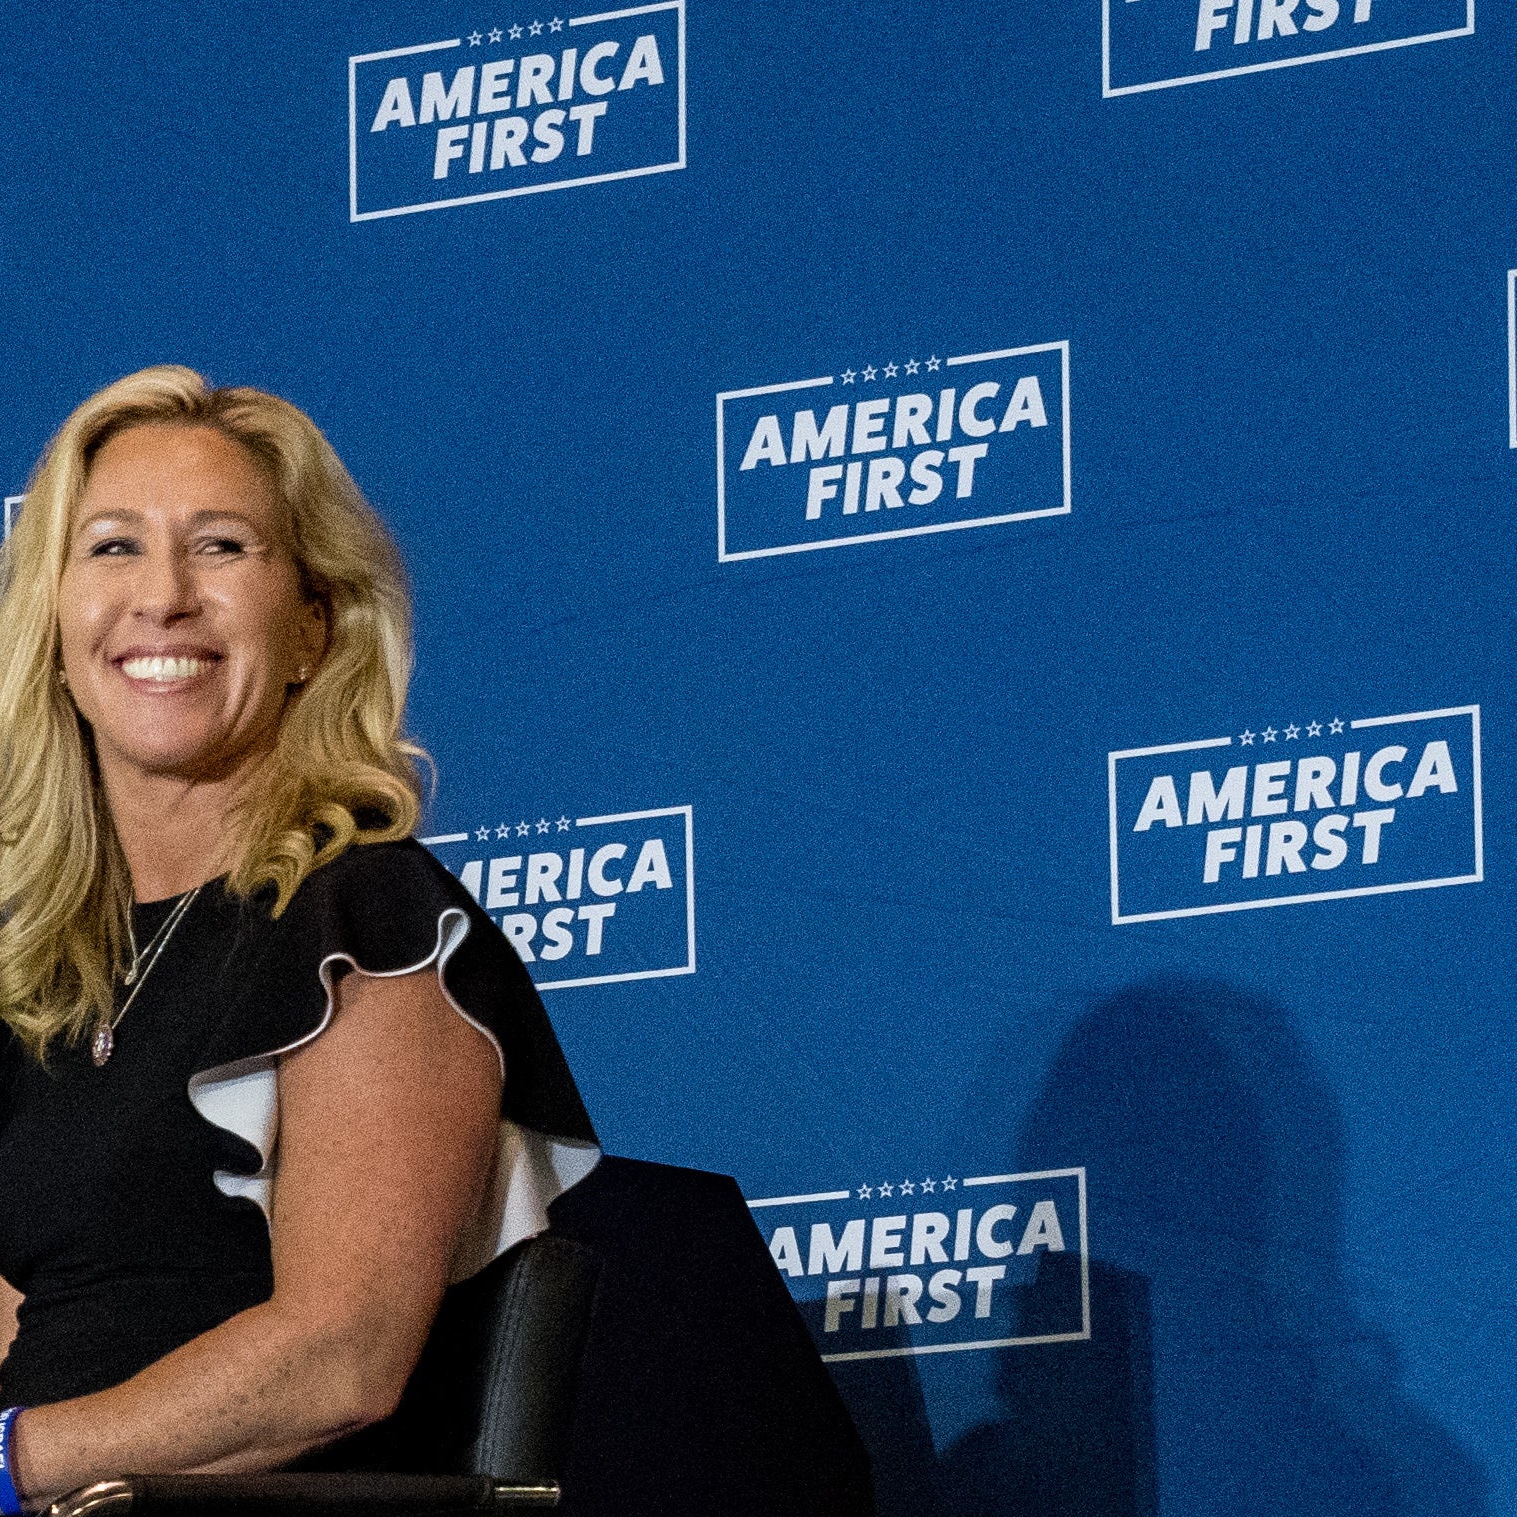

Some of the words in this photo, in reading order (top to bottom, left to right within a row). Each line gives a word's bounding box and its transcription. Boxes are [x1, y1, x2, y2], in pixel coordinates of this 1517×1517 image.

[371, 34, 664, 132] AMERICA
[433, 101, 608, 180] FIRST
[740, 375, 1048, 471] AMERICA
[805, 442, 989, 520] FIRST
[1133, 740, 1458, 832] AMERICA
[1203, 807, 1396, 884] FIRST
[493, 903, 617, 962] RST
[766, 1200, 1064, 1277] AMERICA
[823, 1264, 1006, 1333] FIRST
